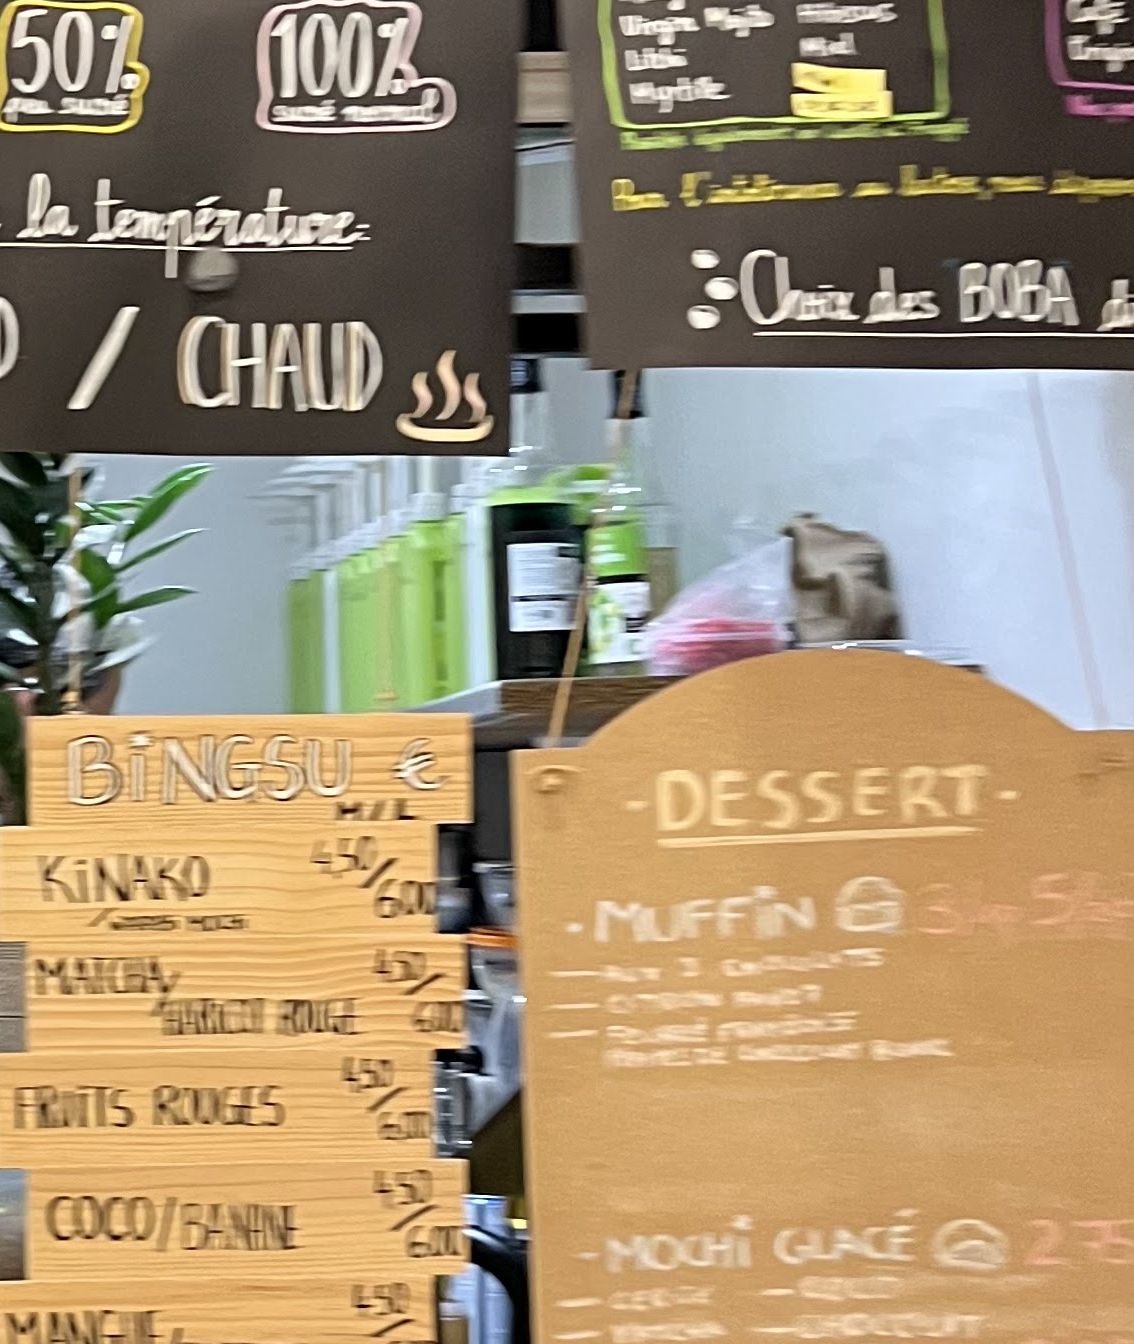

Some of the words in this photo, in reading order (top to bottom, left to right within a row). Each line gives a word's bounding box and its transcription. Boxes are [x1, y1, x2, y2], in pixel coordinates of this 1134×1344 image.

[10, 9, 141, 94] 50%
[269, 12, 407, 99] 100%
[16, 173, 80, 241] la
[740, 249, 860, 325] Choix
[959, 259, 1080, 326] BOBA
[67, 306, 140, 412] /
[177, 315, 384, 413] CHAUD
[392, 738, 449, 791] €
[152, 1084, 286, 1127] ROUGES
[773, 1208, 921, 1266] GLACÉ
